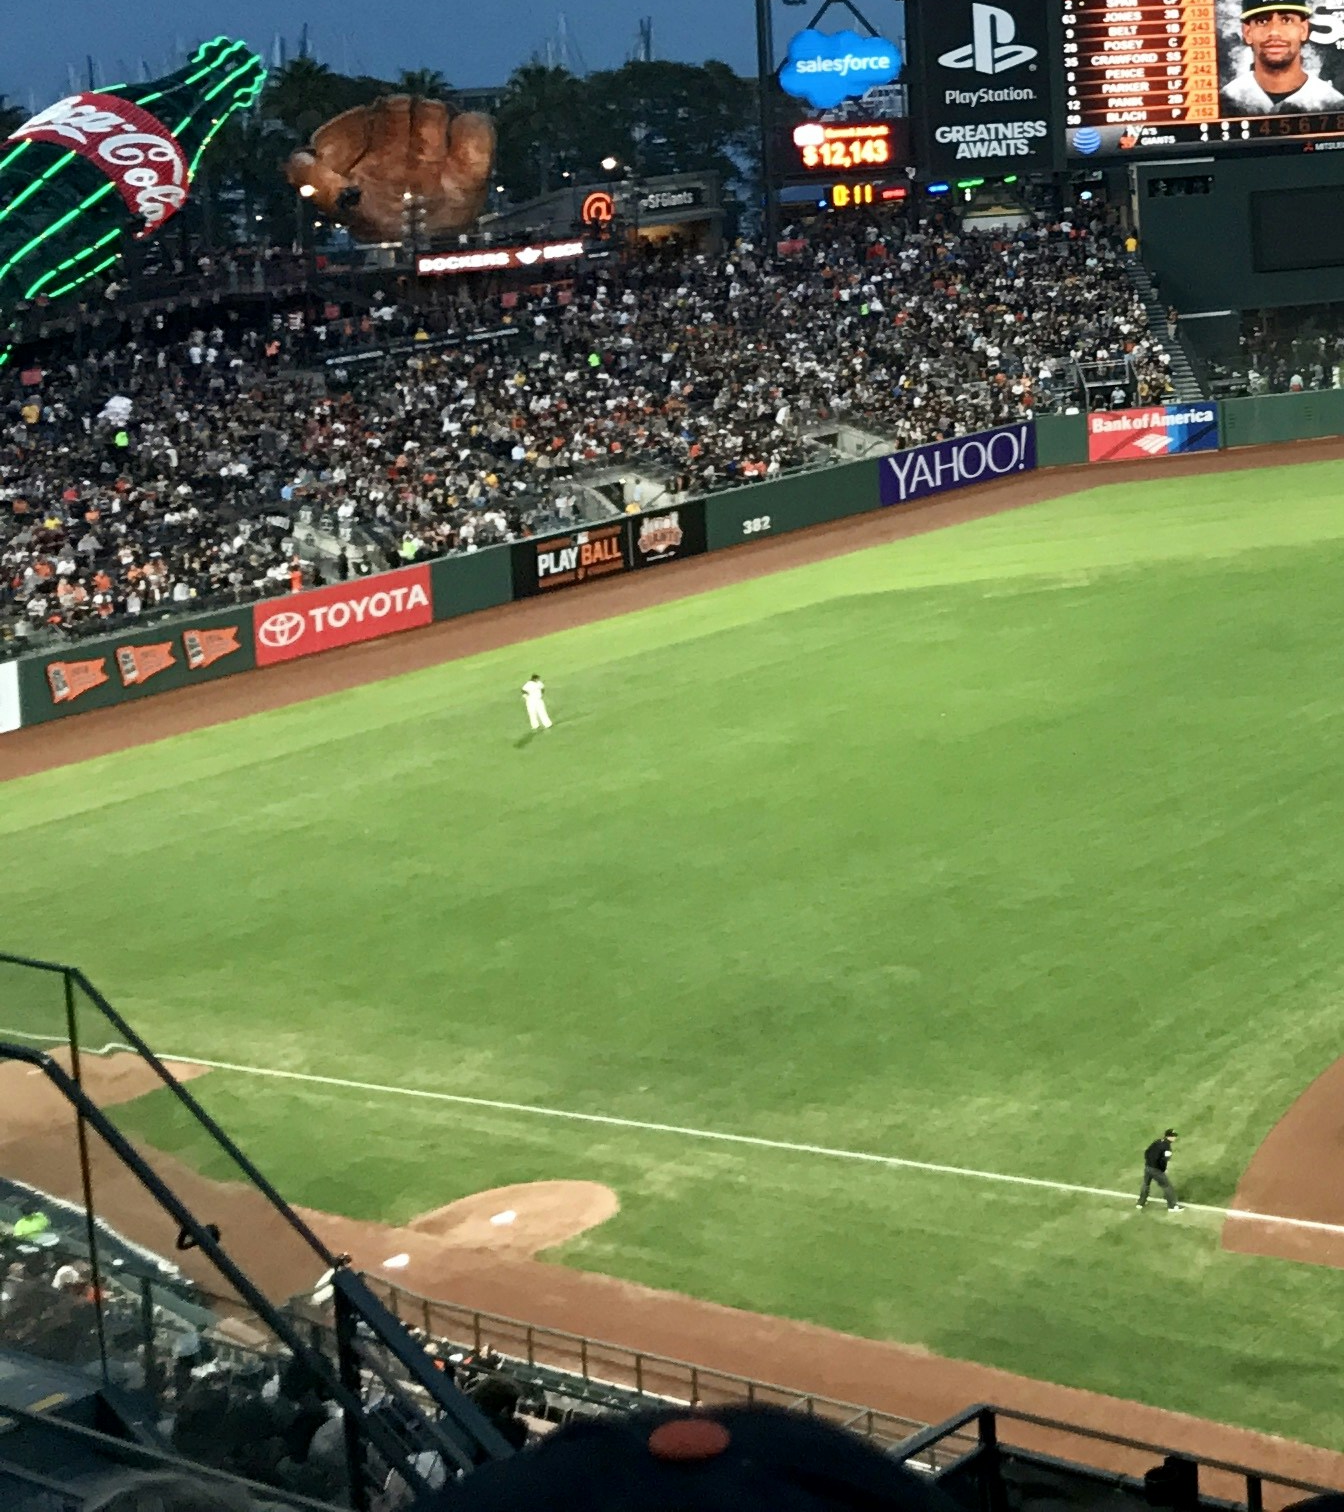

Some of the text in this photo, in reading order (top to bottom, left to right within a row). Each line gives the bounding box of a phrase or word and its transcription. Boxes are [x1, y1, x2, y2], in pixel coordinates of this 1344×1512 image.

[1064, 1, 1072, 10] 2
[1102, 11, 1142, 23] JONES
[1108, 25, 1138, 37] BELT
[1103, 40, 1144, 51] POSEY
[796, 54, 890, 76] salesforce
[1091, 53, 1158, 66] CRAWFORD
[1105, 68, 1145, 79] PENCE
[945, 86, 1034, 108] PlayStation
[1102, 82, 1150, 94] PARKER
[1067, 97, 1144, 110] 12 PANIK
[1106, 111, 1147, 123] BLACH
[1259, 120, 1271, 135] 4
[1279, 119, 1291, 134] 5
[1319, 116, 1329, 131] 7
[935, 120, 1047, 144] GREATNESS
[1141, 135, 1176, 146] GIANTS
[1200, 132, 1209, 142] 4
[803, 139, 888, 168] $12,143
[955, 139, 1031, 160] AWAITS
[8, 95, 186, 226] Coca-Cola
[1092, 409, 1215, 434] Bank of America
[888, 425, 1028, 500] YAHOO!
[742, 515, 772, 535] 382
[537, 536, 622, 578] PLAY BALL
[309, 582, 430, 634] TOYOTA
